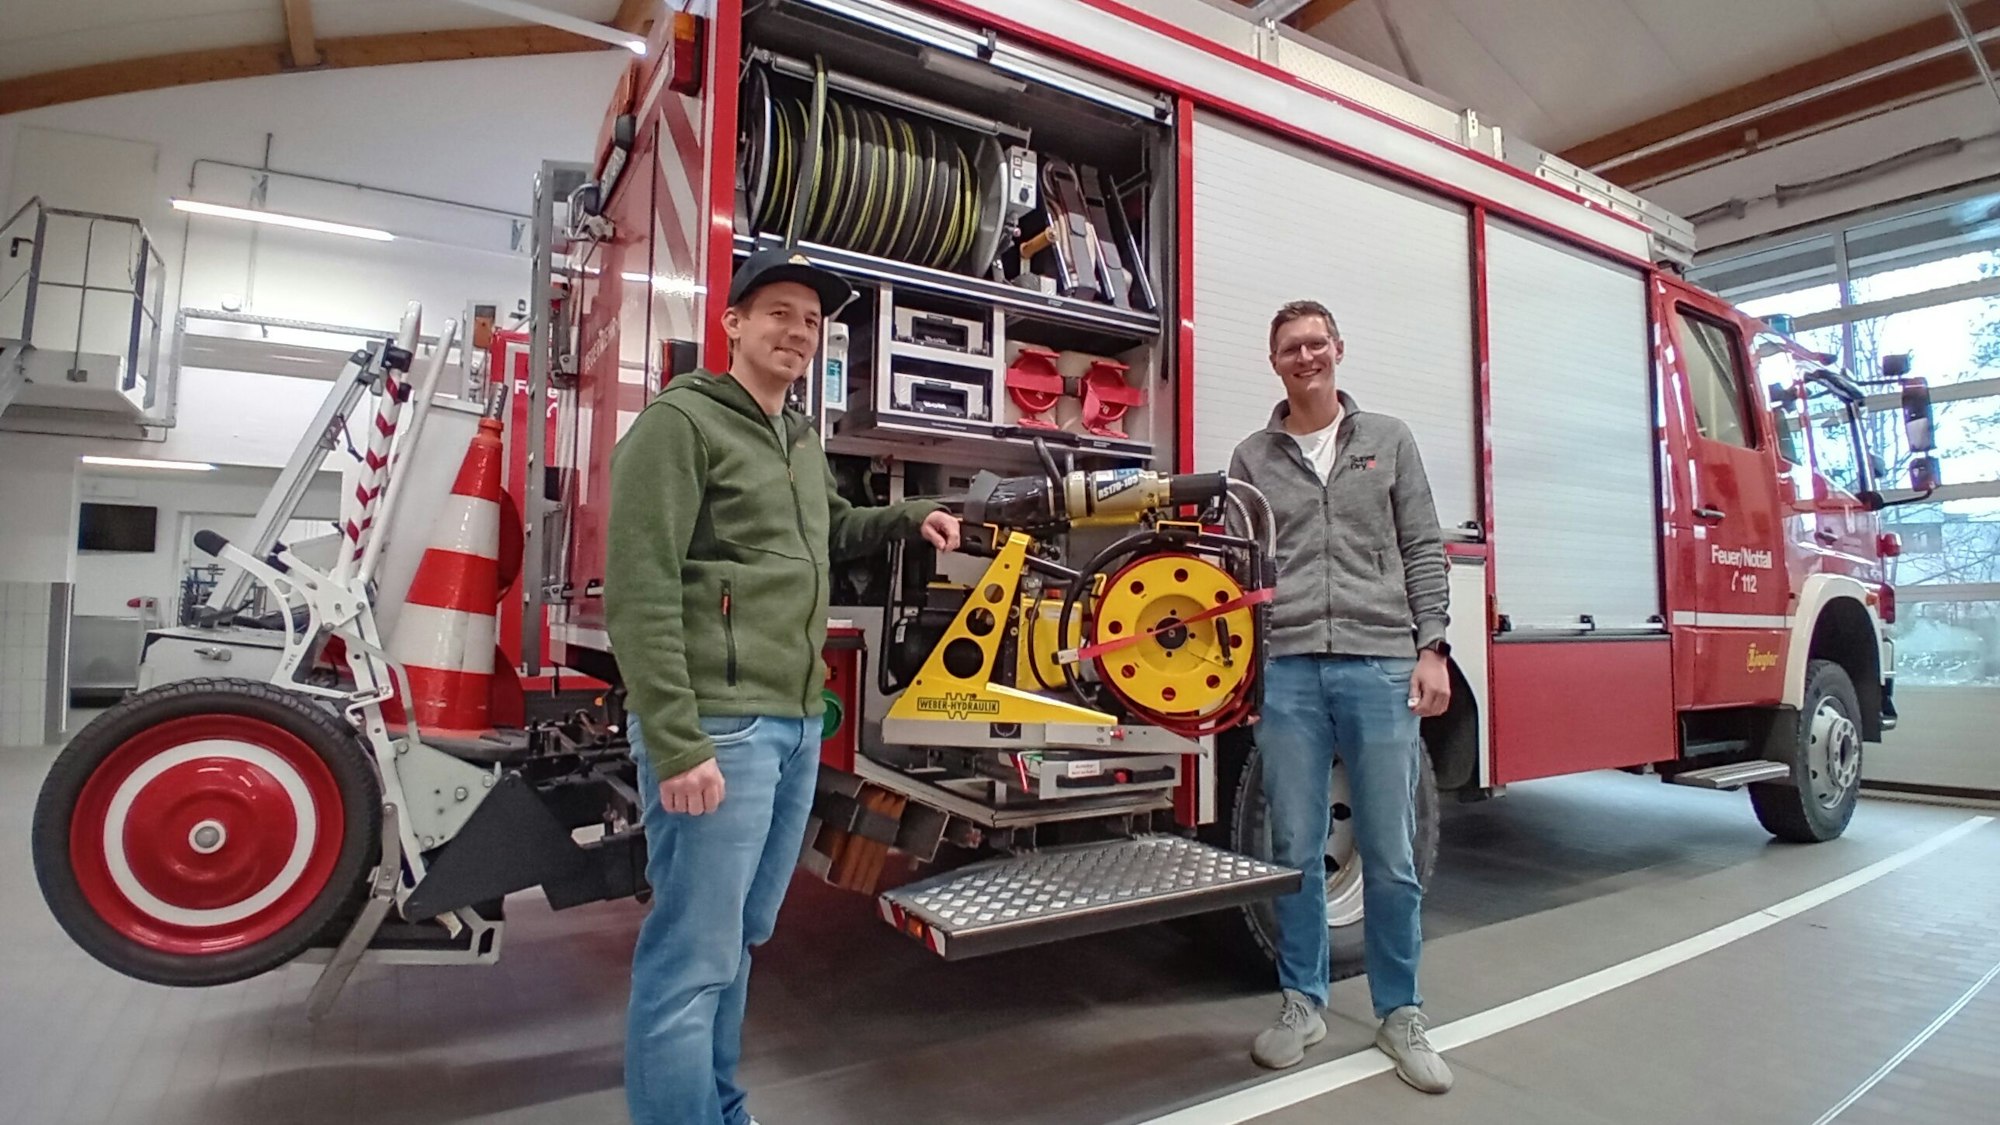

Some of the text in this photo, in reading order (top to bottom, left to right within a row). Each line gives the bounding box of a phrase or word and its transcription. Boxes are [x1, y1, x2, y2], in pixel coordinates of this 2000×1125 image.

[1711, 543, 1773, 569] Feuer/Notfall
[1741, 574, 1757, 593] 112
[919, 700, 997, 712] WEBER-HYDRAULIK
